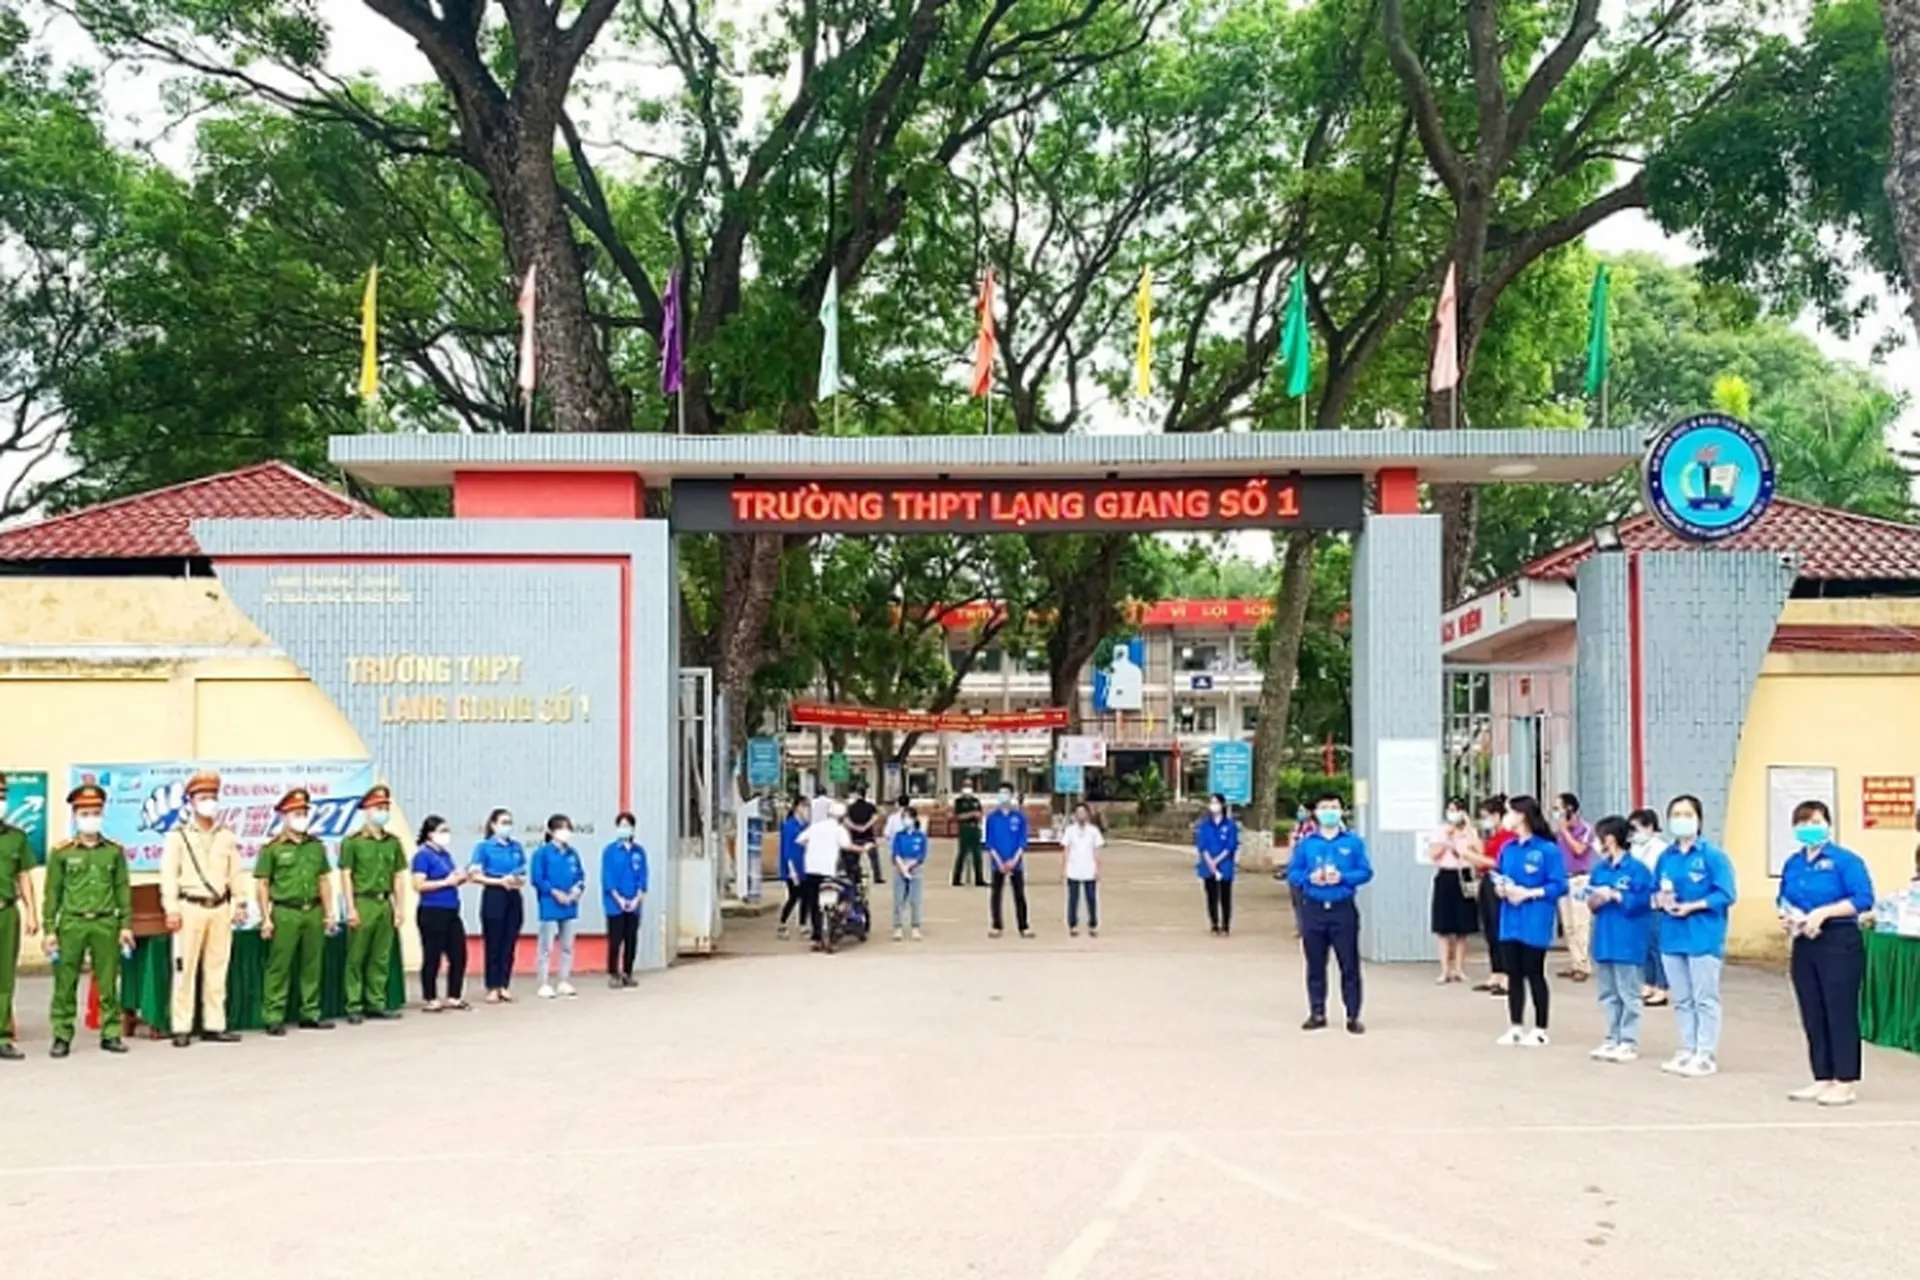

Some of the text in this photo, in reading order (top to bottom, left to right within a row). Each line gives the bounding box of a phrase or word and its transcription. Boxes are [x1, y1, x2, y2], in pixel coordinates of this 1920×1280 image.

[732, 478, 1299, 526] TRƯỜNG THPT LẠNG GIANG SỐ 1
[458, 655, 523, 685] THPT
[381, 692, 447, 727] LẠNG
[456, 692, 533, 723] GIANG
[538, 683, 573, 723] SỐ
